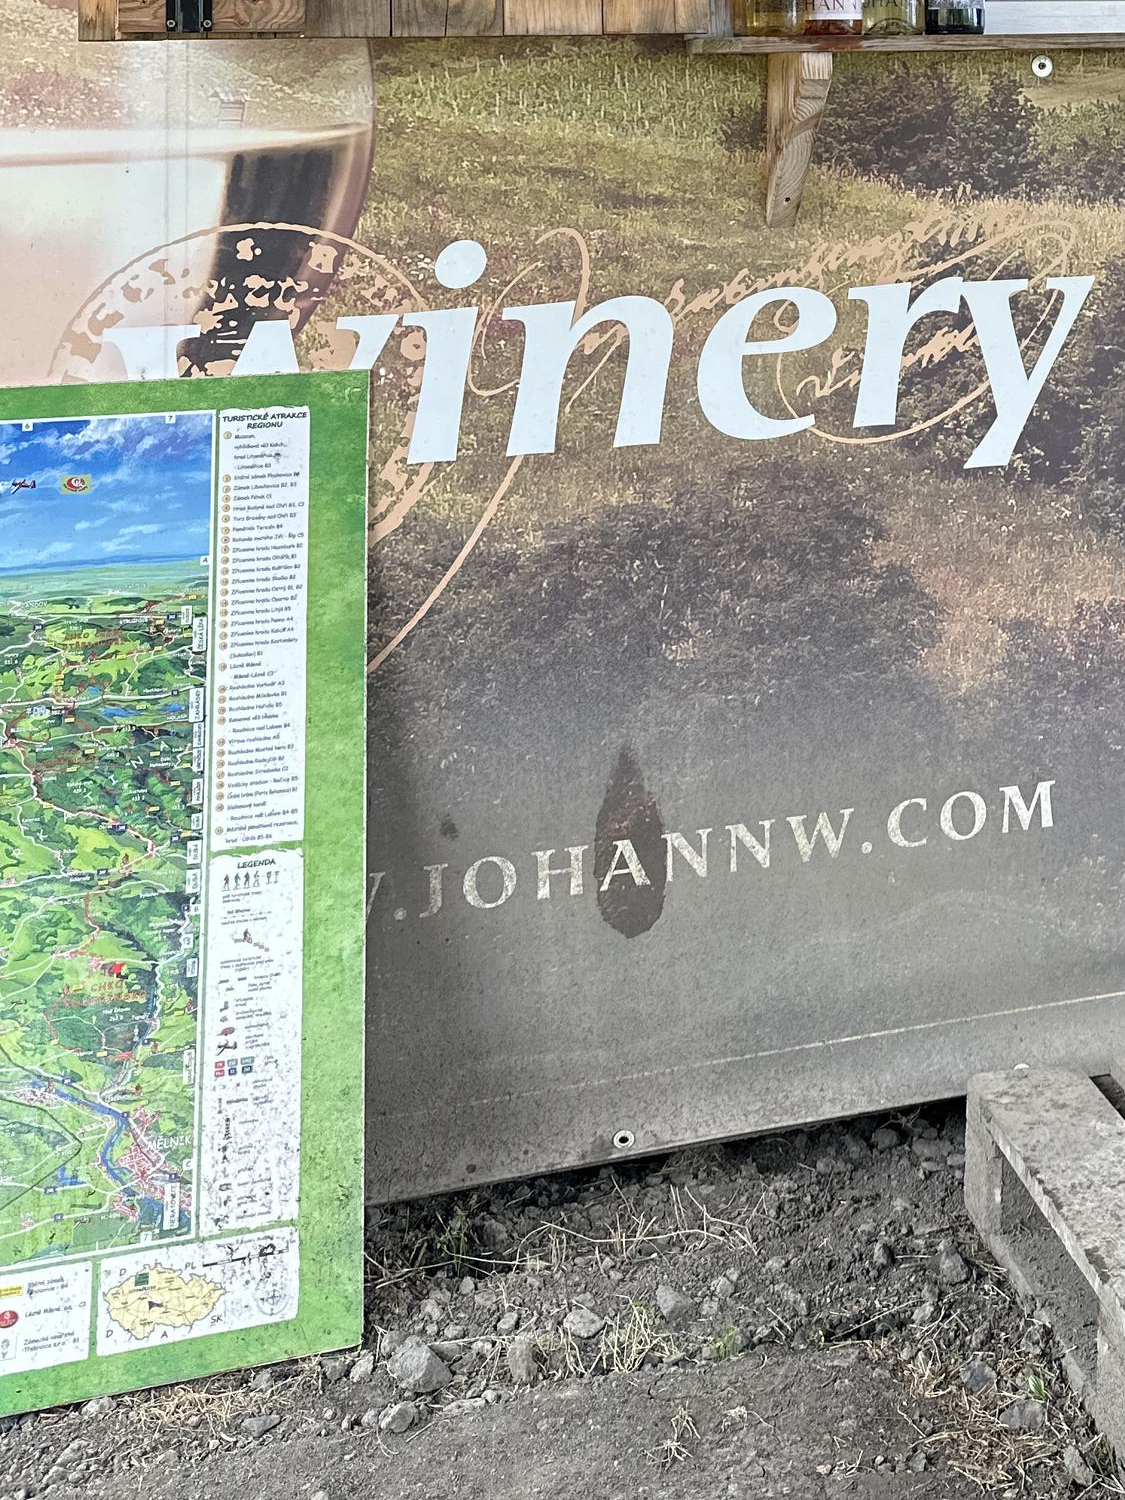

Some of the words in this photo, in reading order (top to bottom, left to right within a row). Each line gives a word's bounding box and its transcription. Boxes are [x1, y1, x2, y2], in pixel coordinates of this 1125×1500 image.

[168, 415, 173, 423] 7
[222, 412, 270, 423] TURISTICKÉ
[270, 411, 308, 420] ATRAKCE
[247, 421, 283, 430] REGIONU
[237, 858, 277, 869] LEGENDA
[148, 1134, 192, 1151] MĚLNÍK
[119, 1268, 127, 1276] D
[184, 1262, 197, 1270] PL
[210, 1314, 223, 1324] SK
[106, 1330, 114, 1338] D
[160, 1331, 168, 1339] A
[24, 1337, 49, 1346] Zámecké
[24, 1343, 52, 1353] Třebívlice
